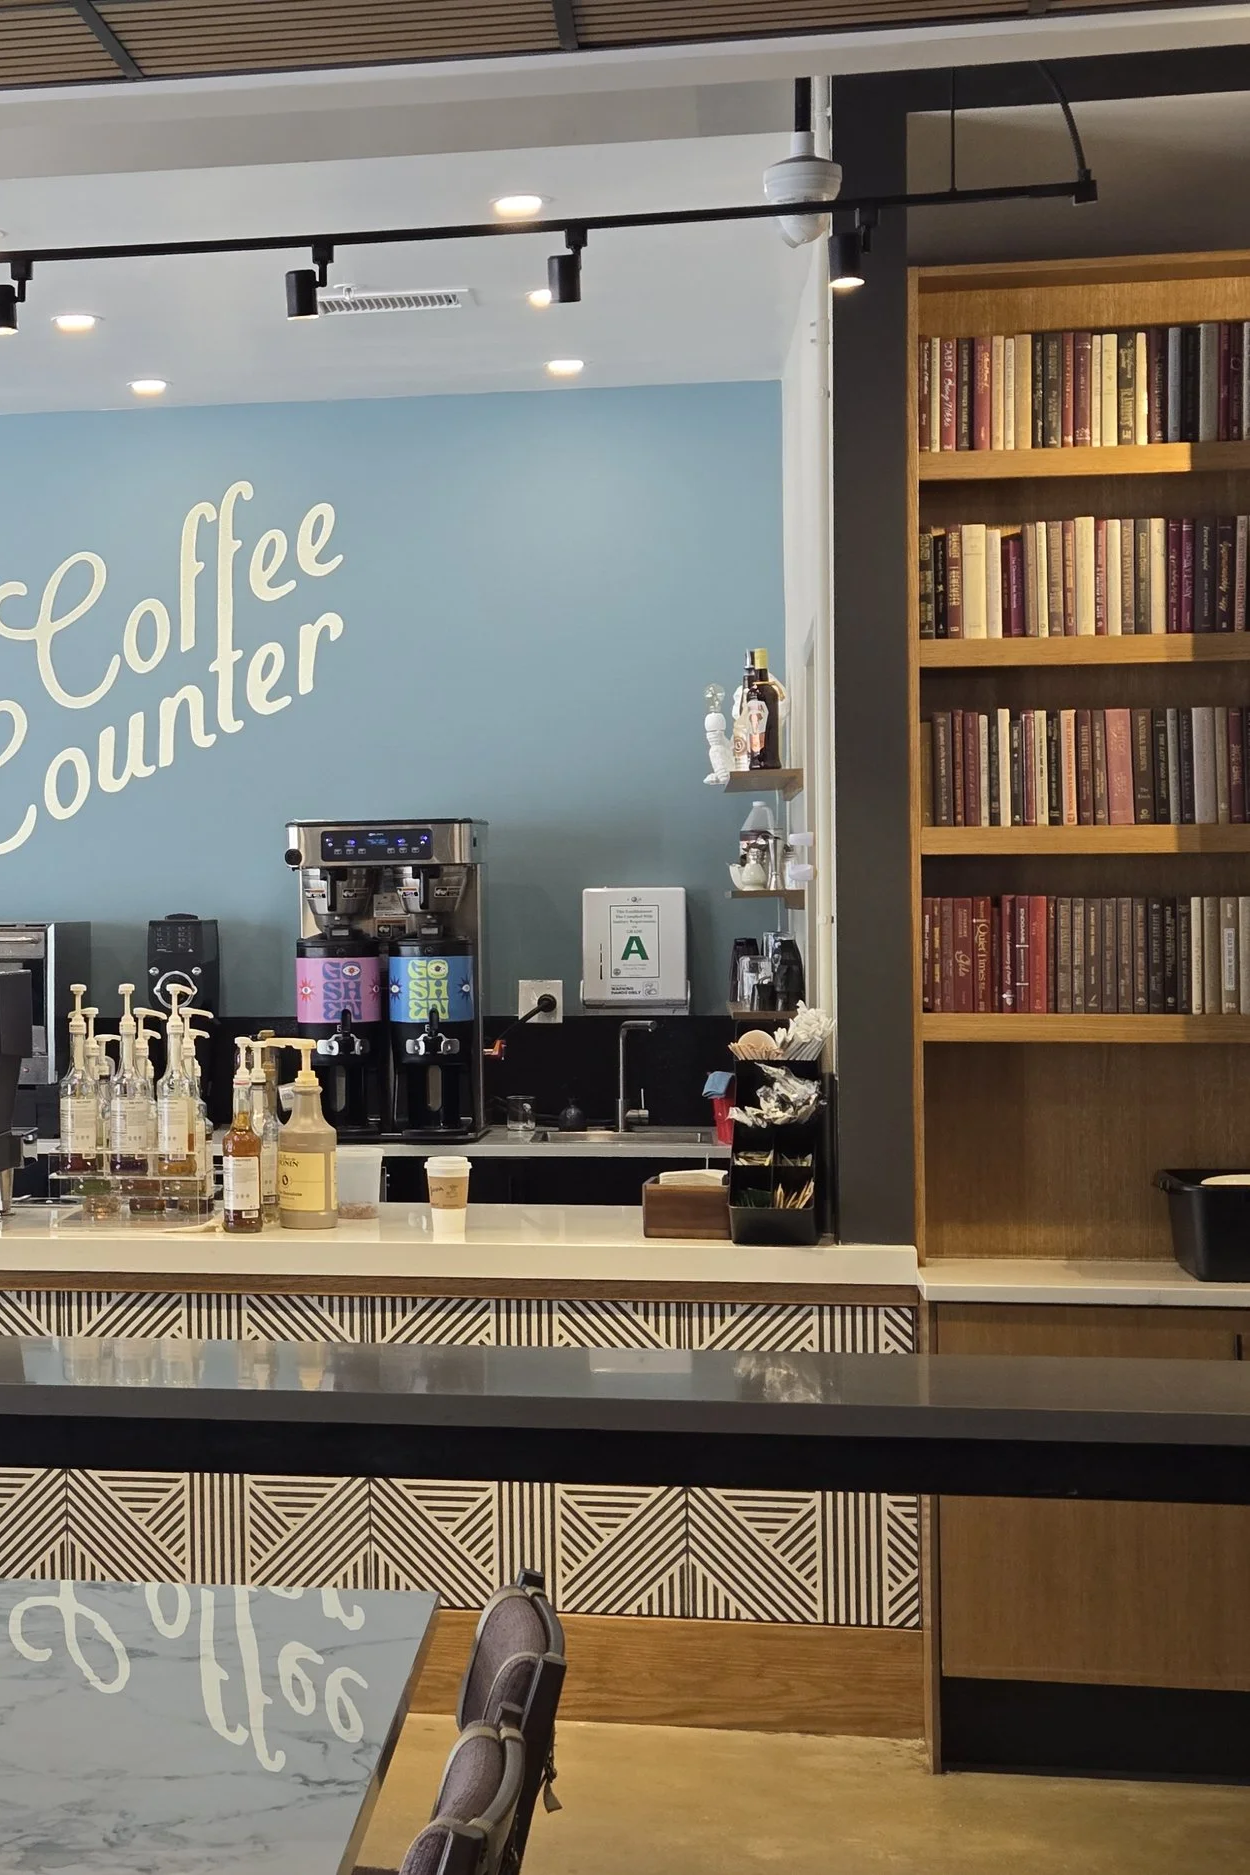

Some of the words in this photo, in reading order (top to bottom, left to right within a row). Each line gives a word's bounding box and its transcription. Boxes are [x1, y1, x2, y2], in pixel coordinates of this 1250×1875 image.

[944, 342, 953, 372] CABOT
[1123, 526, 1131, 555] JAMES
[1123, 557, 1131, 607] PATTERSON
[1138, 716, 1146, 744] SANDRA
[1139, 746, 1147, 771] BROWN
[621, 936, 649, 960] A
[975, 924, 988, 951] Quiet
